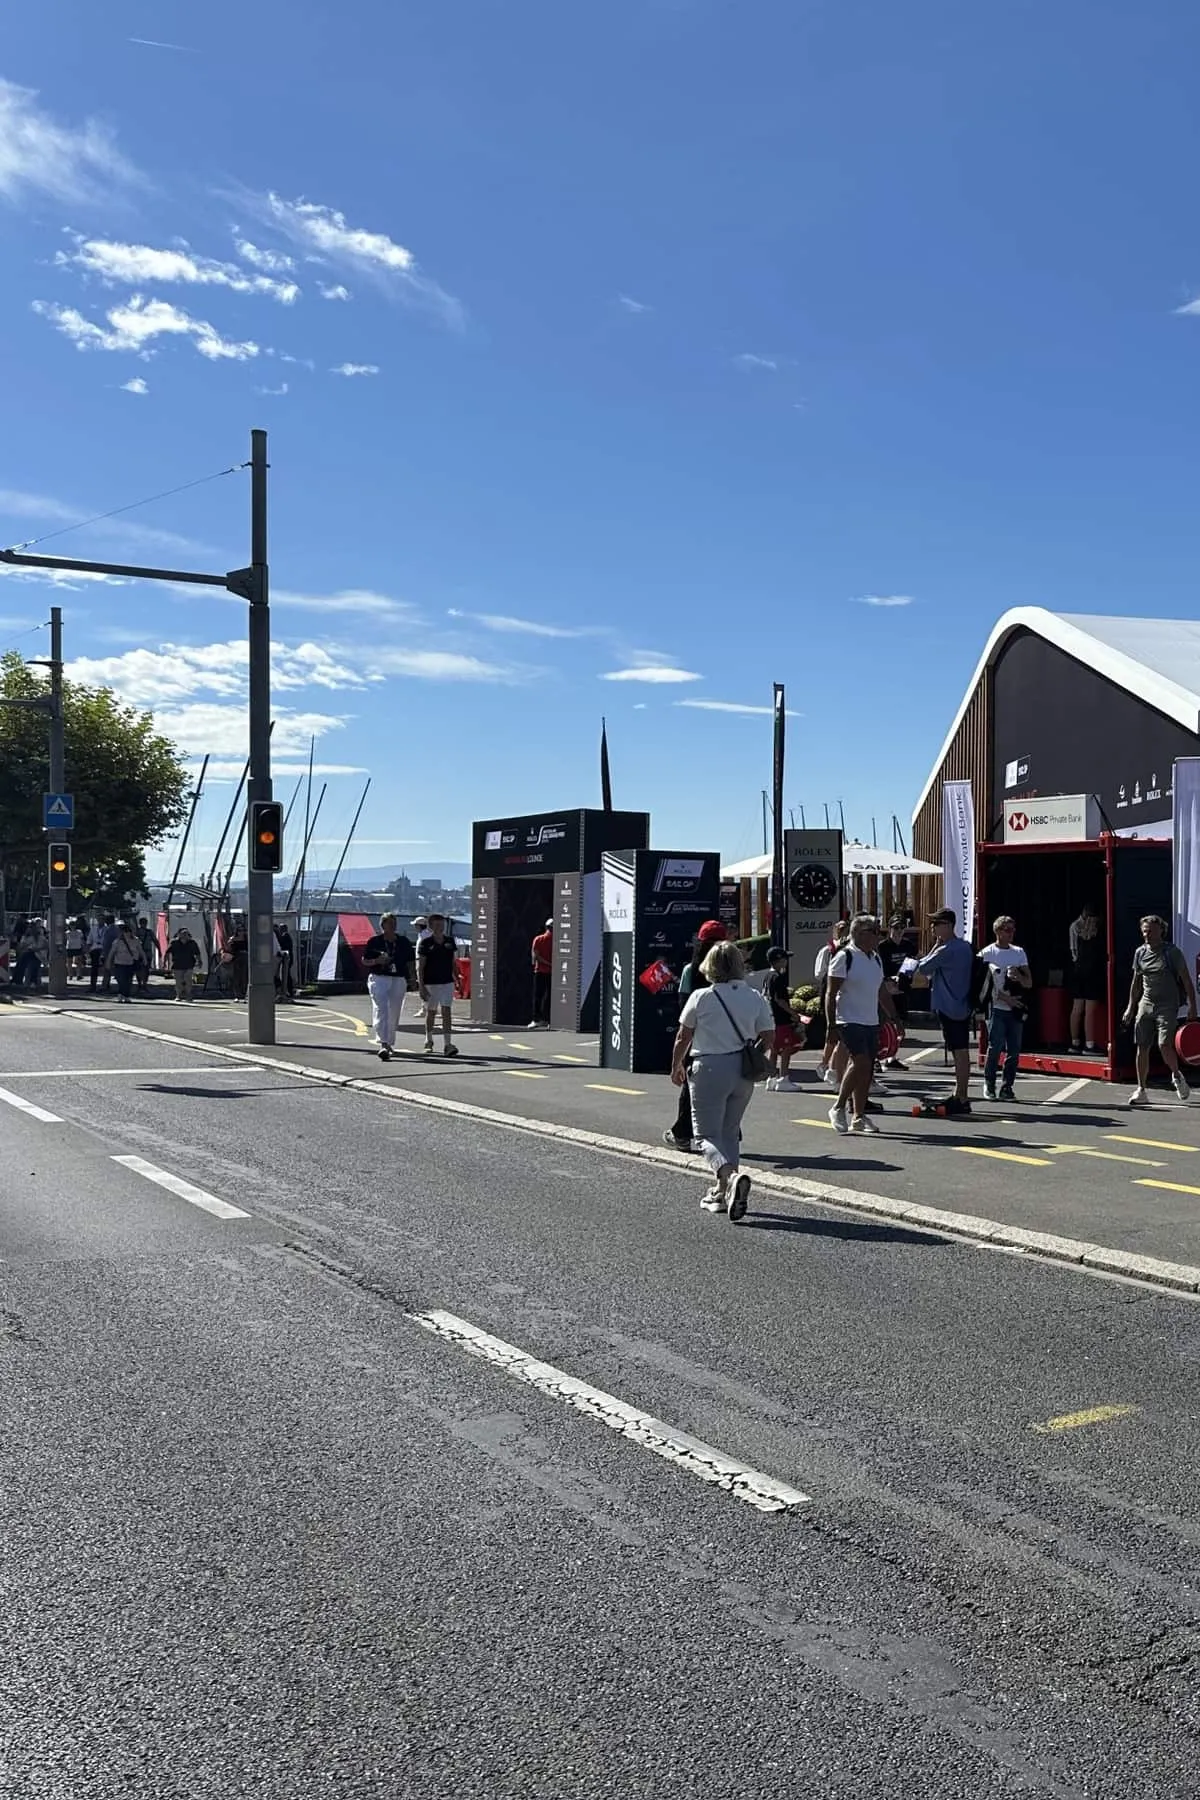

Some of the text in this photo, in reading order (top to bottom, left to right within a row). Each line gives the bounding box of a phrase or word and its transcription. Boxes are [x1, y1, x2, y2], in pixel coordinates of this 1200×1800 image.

[956, 792, 966, 828] Bank
[1030, 813, 1082, 825] HSBC Private Bank
[794, 848, 832, 856] ROLEX
